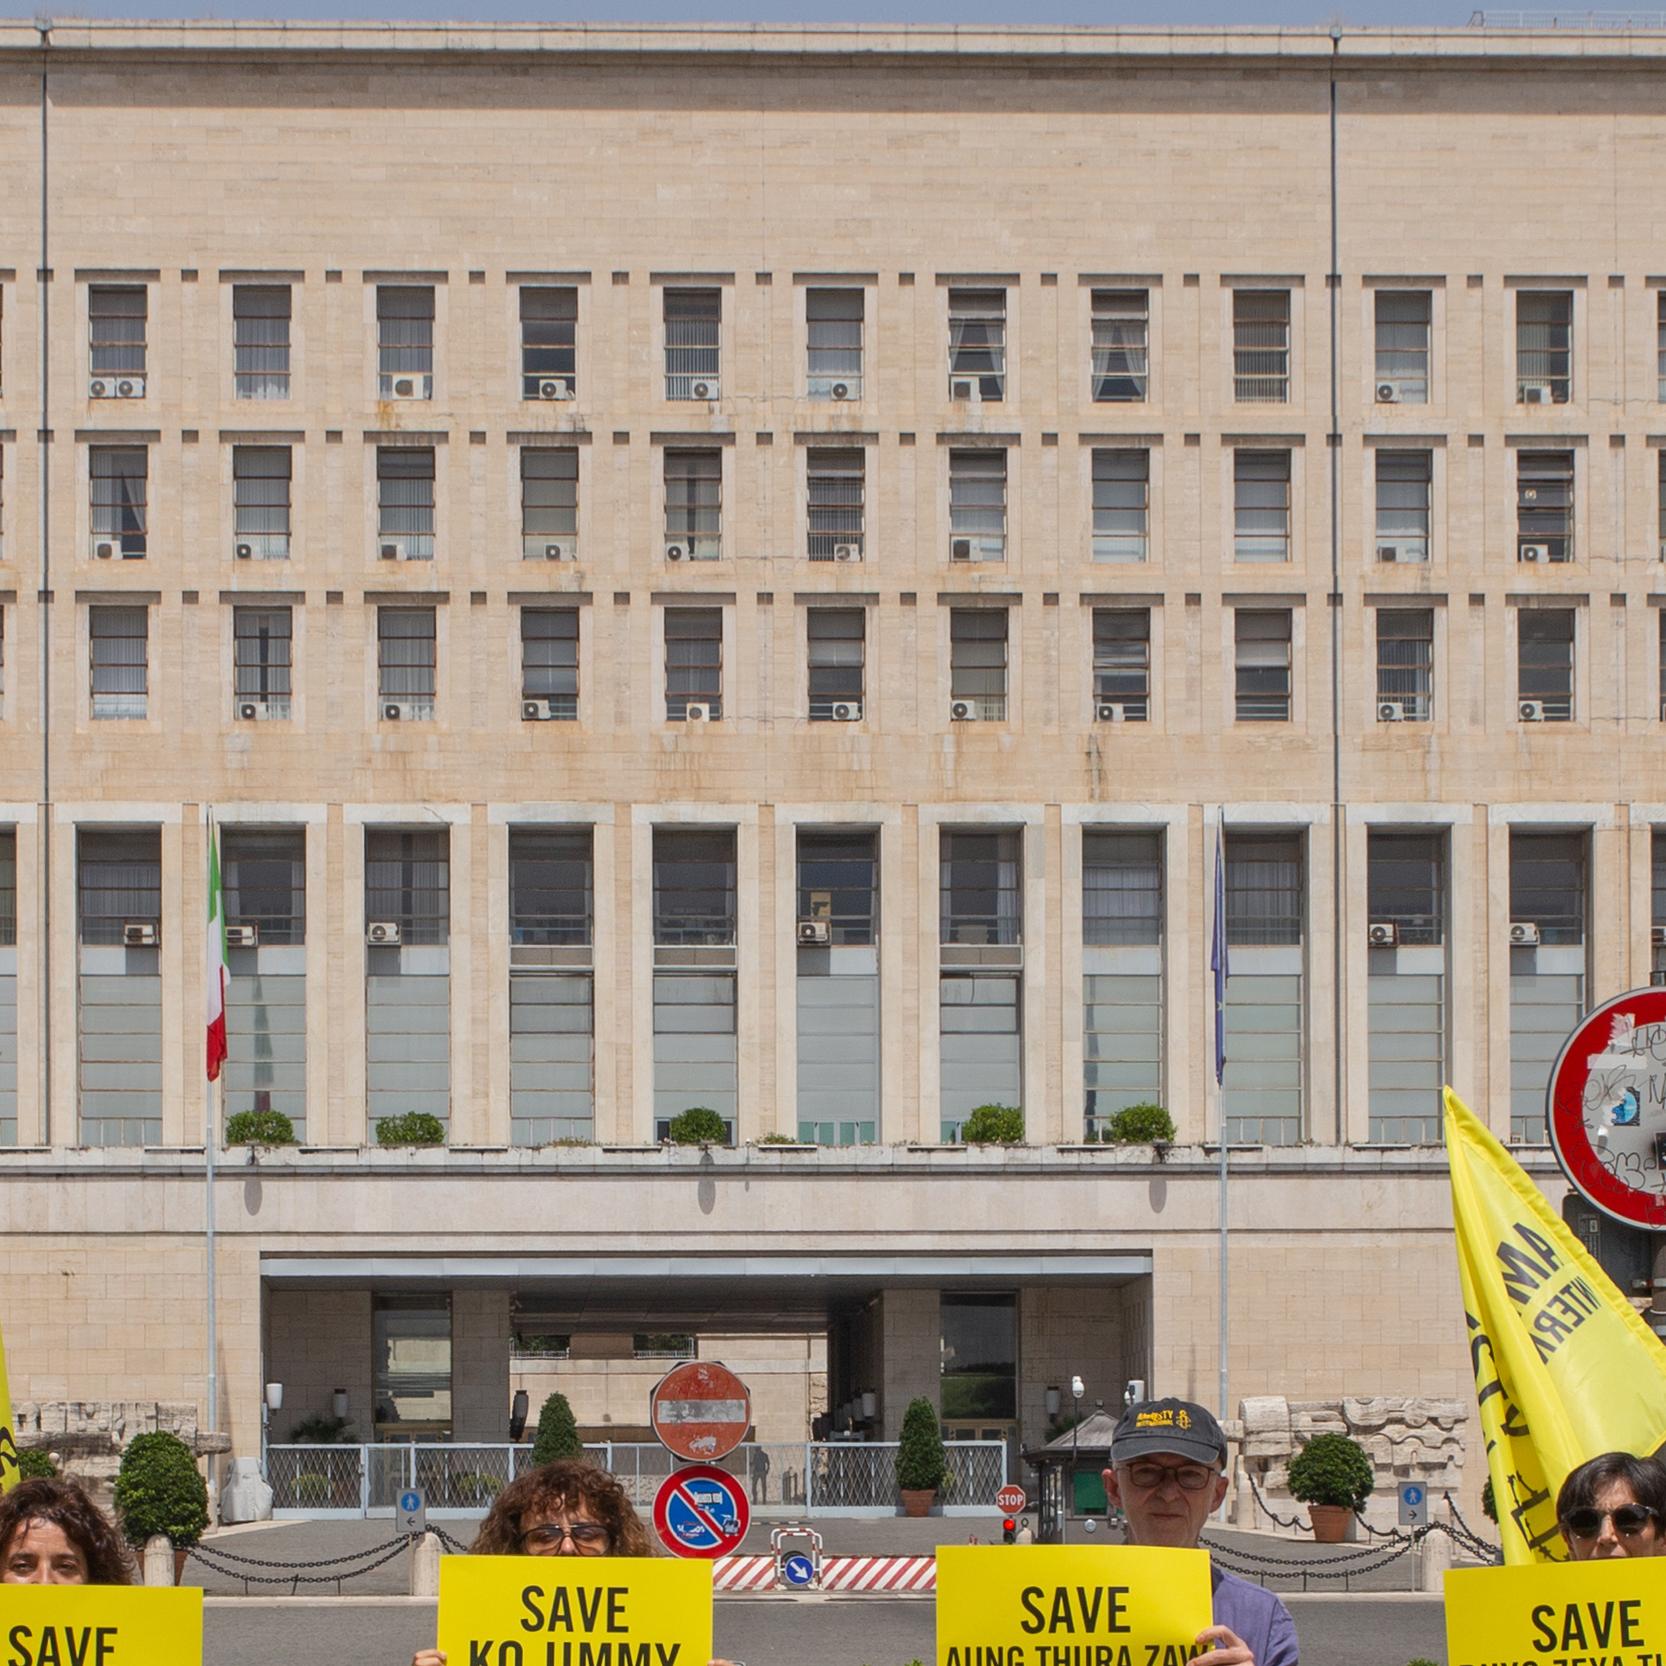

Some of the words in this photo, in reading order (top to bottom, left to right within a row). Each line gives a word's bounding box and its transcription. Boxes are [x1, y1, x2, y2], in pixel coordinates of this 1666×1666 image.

[998, 1494, 1023, 1506] STOP
[520, 1585, 629, 1633] SAVE
[1020, 1586, 1131, 1634] SAVE
[1531, 1599, 1645, 1653] SAVE
